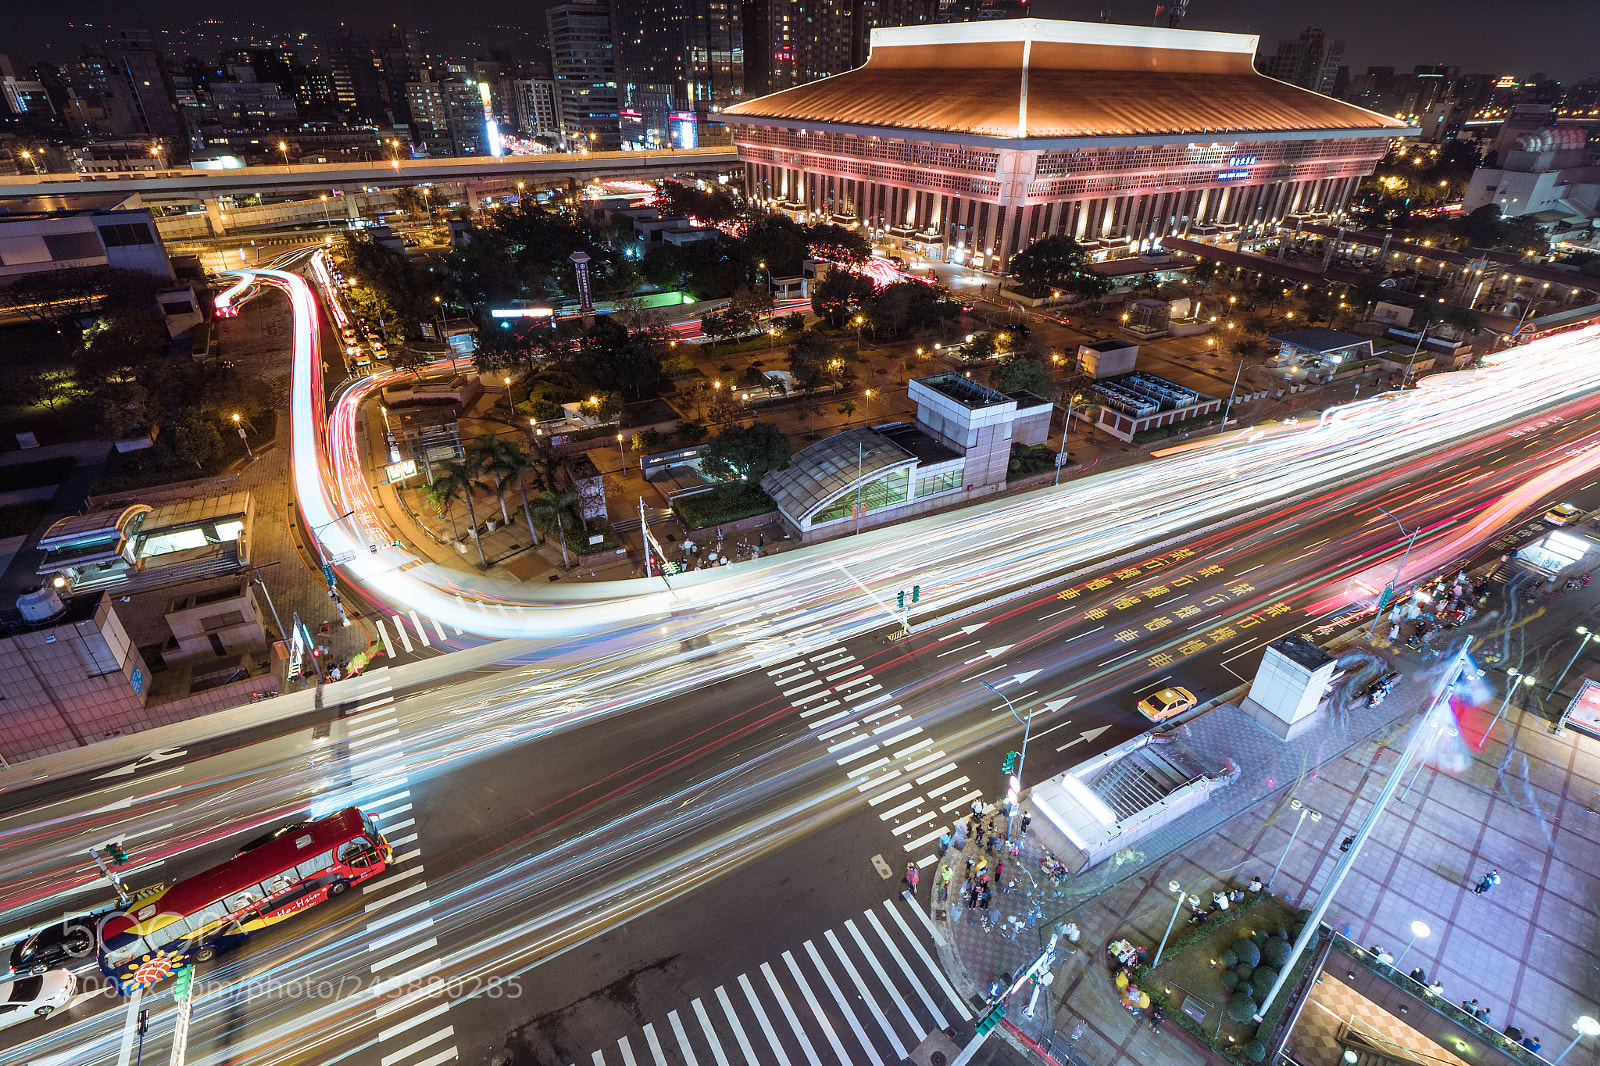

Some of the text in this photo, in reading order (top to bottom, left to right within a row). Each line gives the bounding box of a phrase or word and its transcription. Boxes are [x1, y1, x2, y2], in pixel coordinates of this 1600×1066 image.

[1057, 548, 1195, 601] 禁行機慢車
[1084, 564, 1225, 621] 禁行機慢車
[1114, 582, 1256, 643] 禁行機慢車
[1148, 602, 1292, 668] 禁行機慢車
